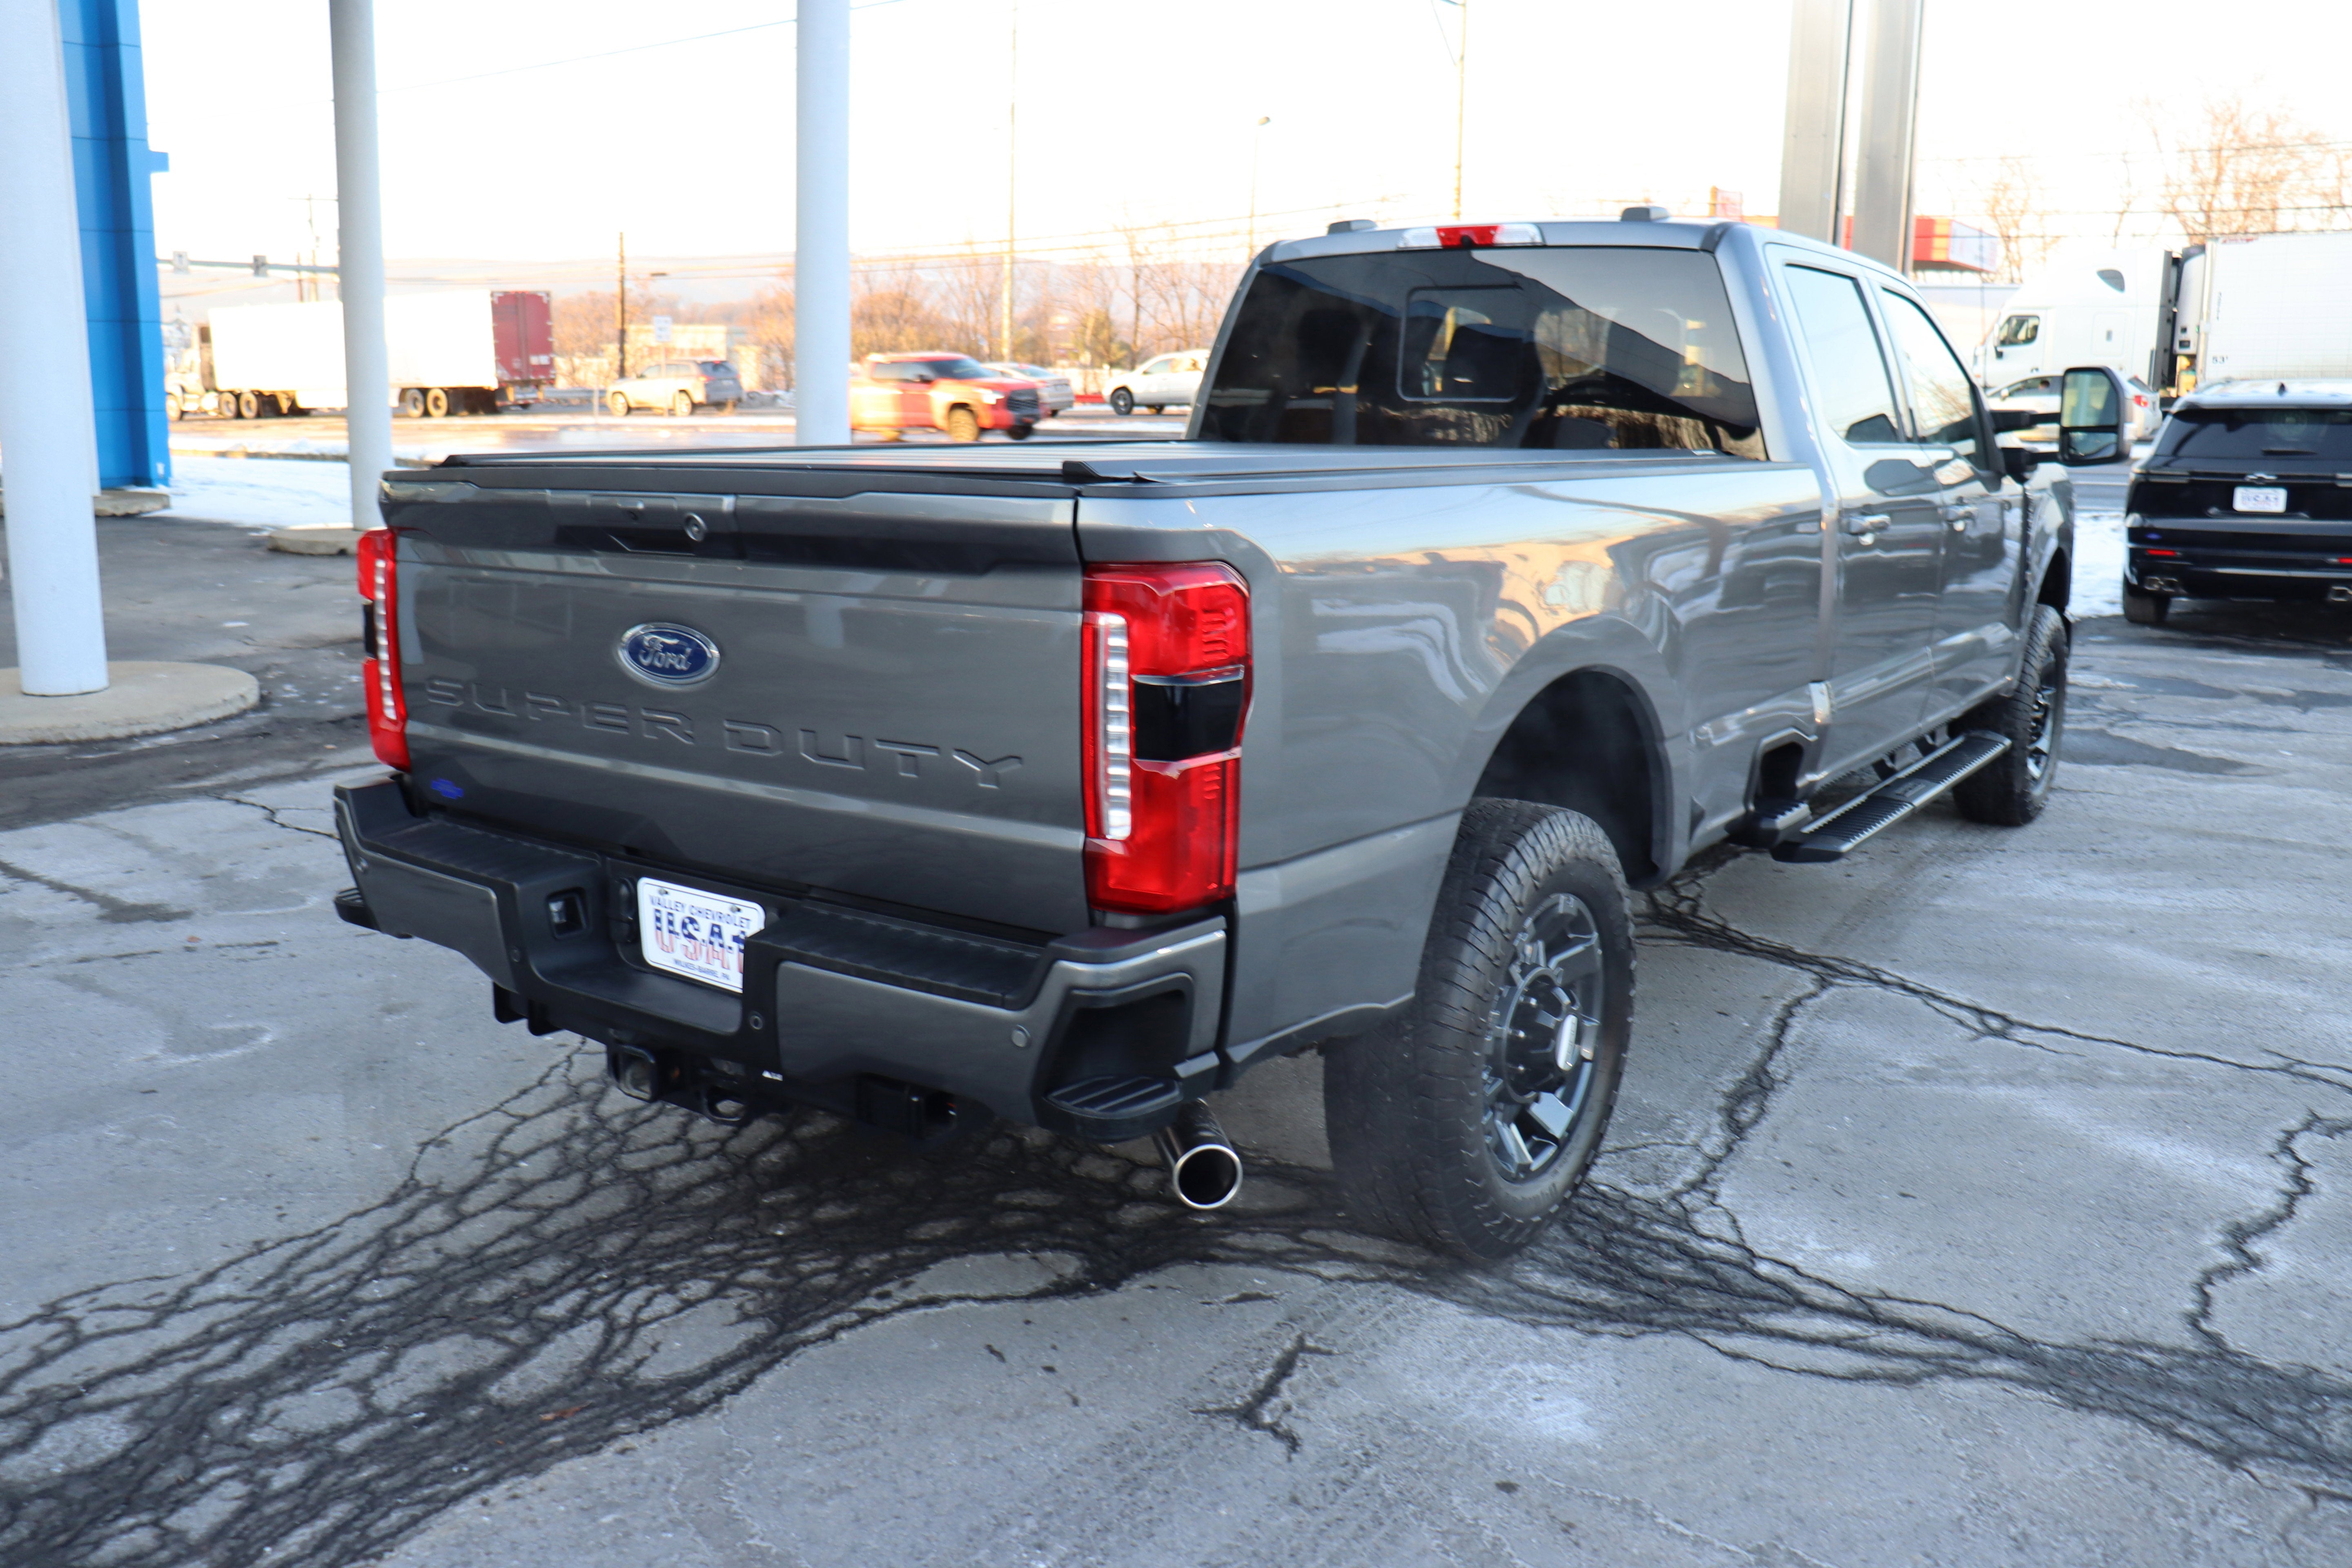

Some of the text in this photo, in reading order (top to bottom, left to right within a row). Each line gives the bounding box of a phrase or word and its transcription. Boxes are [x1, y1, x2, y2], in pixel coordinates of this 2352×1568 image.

[639, 634, 693, 671] Ford
[425, 678, 1022, 790] SUPER DUTY
[649, 895, 751, 929] VALLEY CHEVROLET
